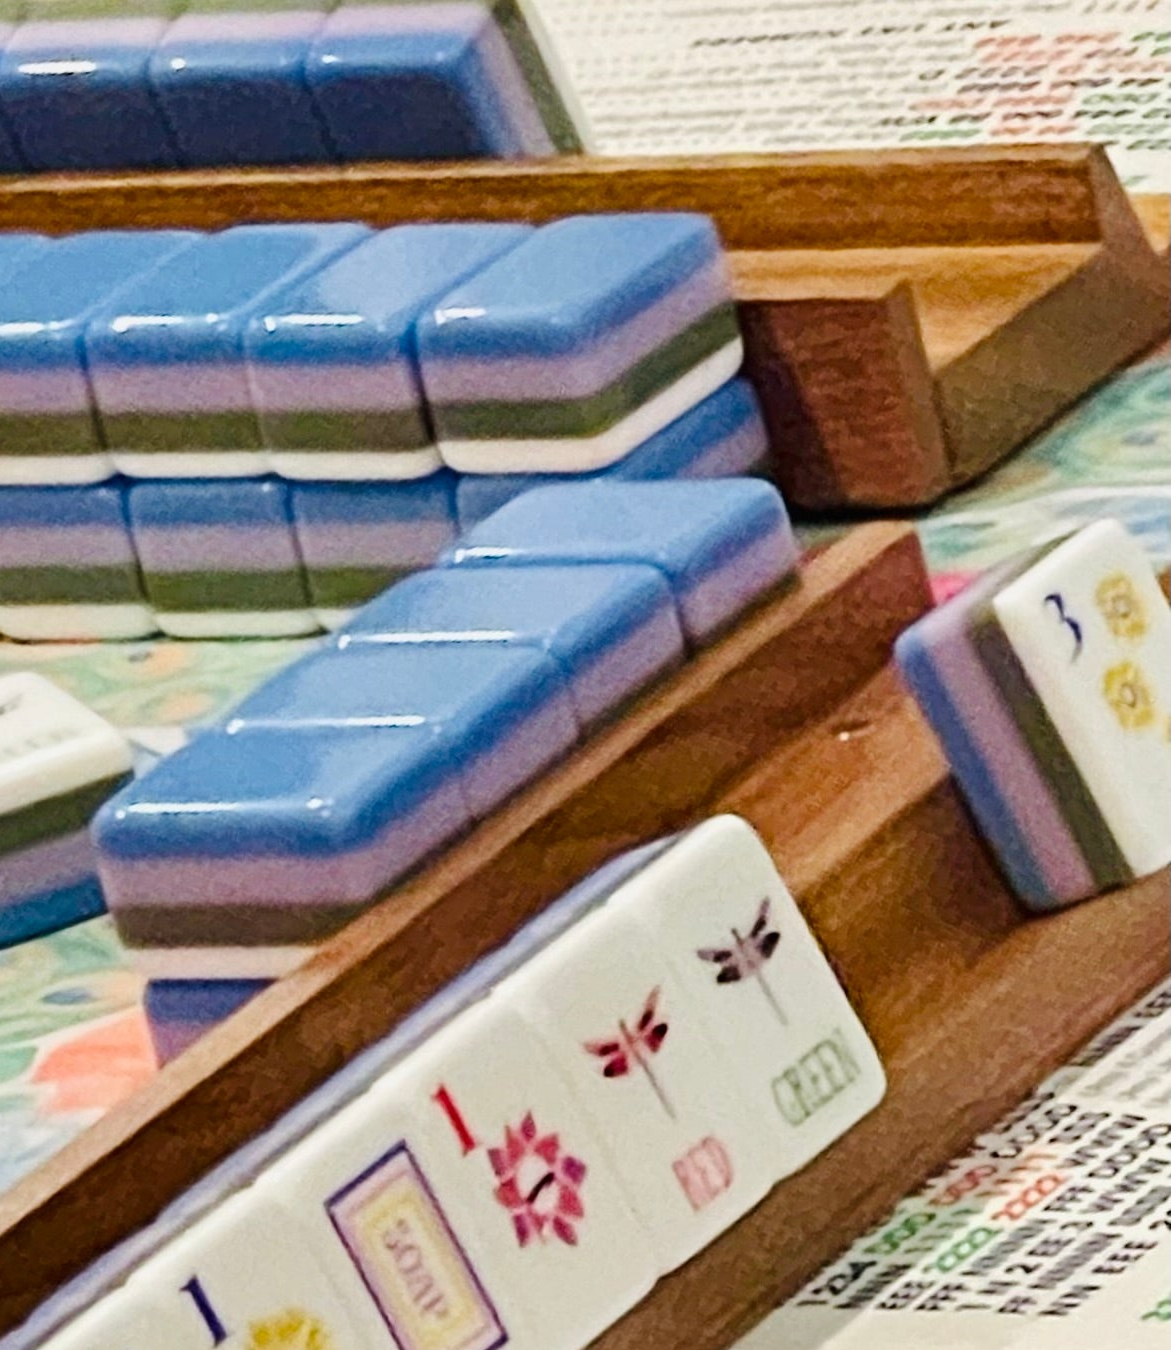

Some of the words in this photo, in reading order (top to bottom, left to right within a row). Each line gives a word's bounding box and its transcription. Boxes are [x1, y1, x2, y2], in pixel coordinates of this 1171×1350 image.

[1044, 592, 1083, 662] 3
[432, 1084, 477, 1156] 1
[180, 1275, 230, 1347] 1
